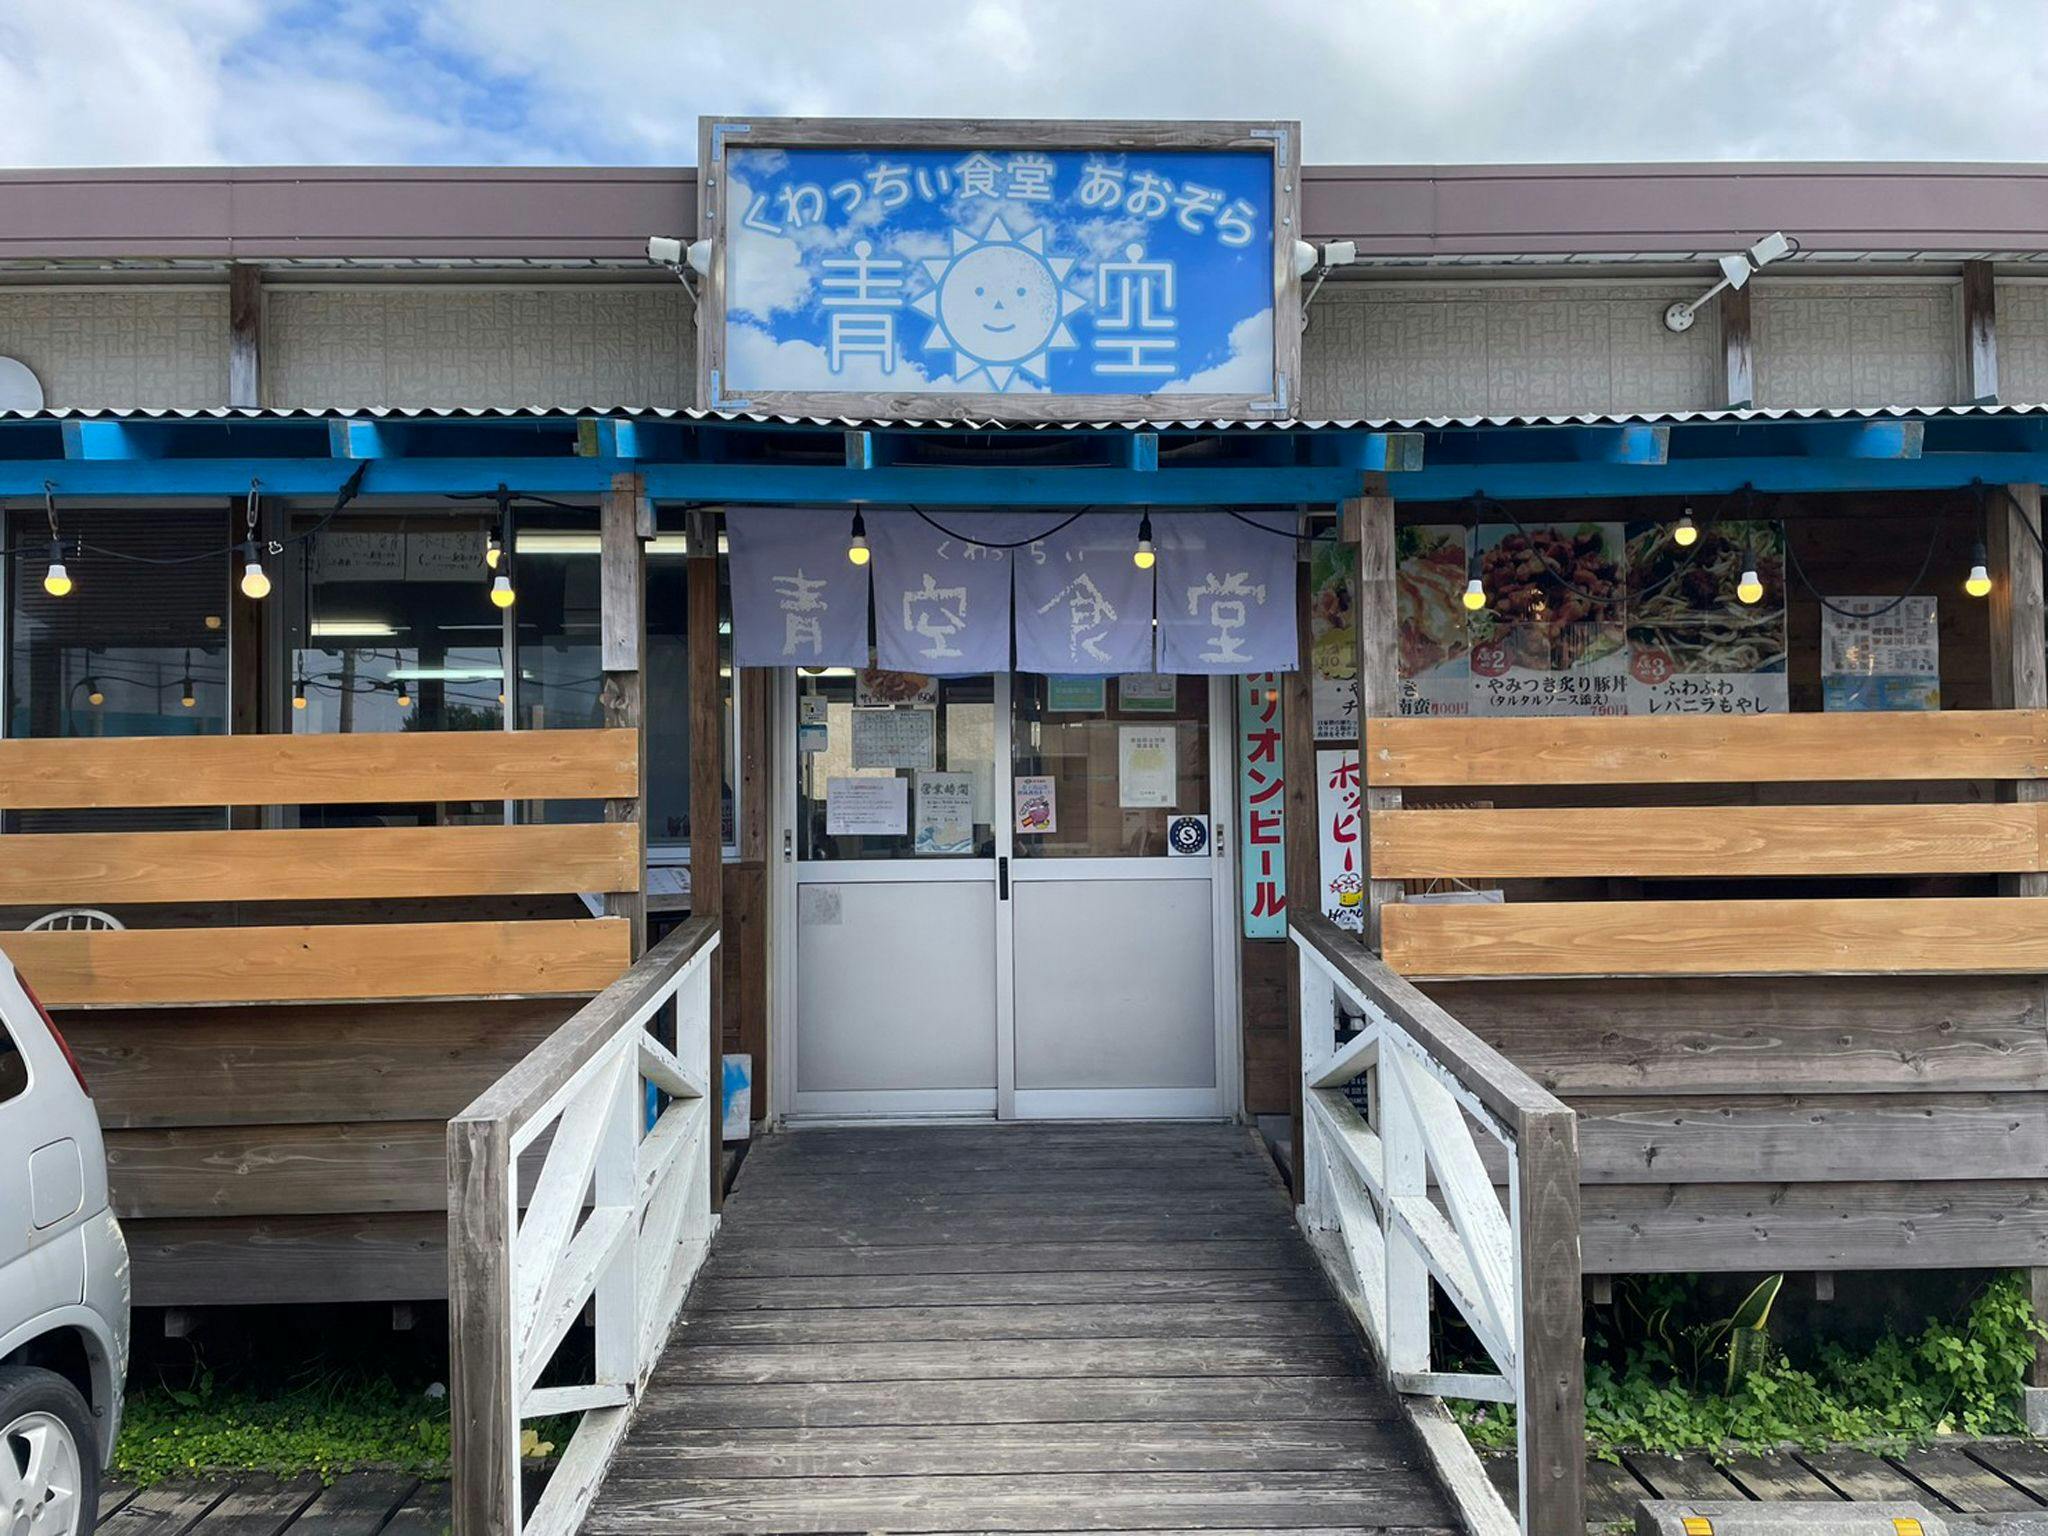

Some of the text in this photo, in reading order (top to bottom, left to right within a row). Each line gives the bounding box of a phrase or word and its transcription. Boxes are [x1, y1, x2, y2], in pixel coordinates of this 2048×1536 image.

[743, 153, 1257, 247] くわっちい食堂 あおぞら
[1649, 697, 1769, 714] レバニラもやし
[1664, 679, 1734, 696] ふわふわ
[1246, 673, 1287, 918] リオンビール
